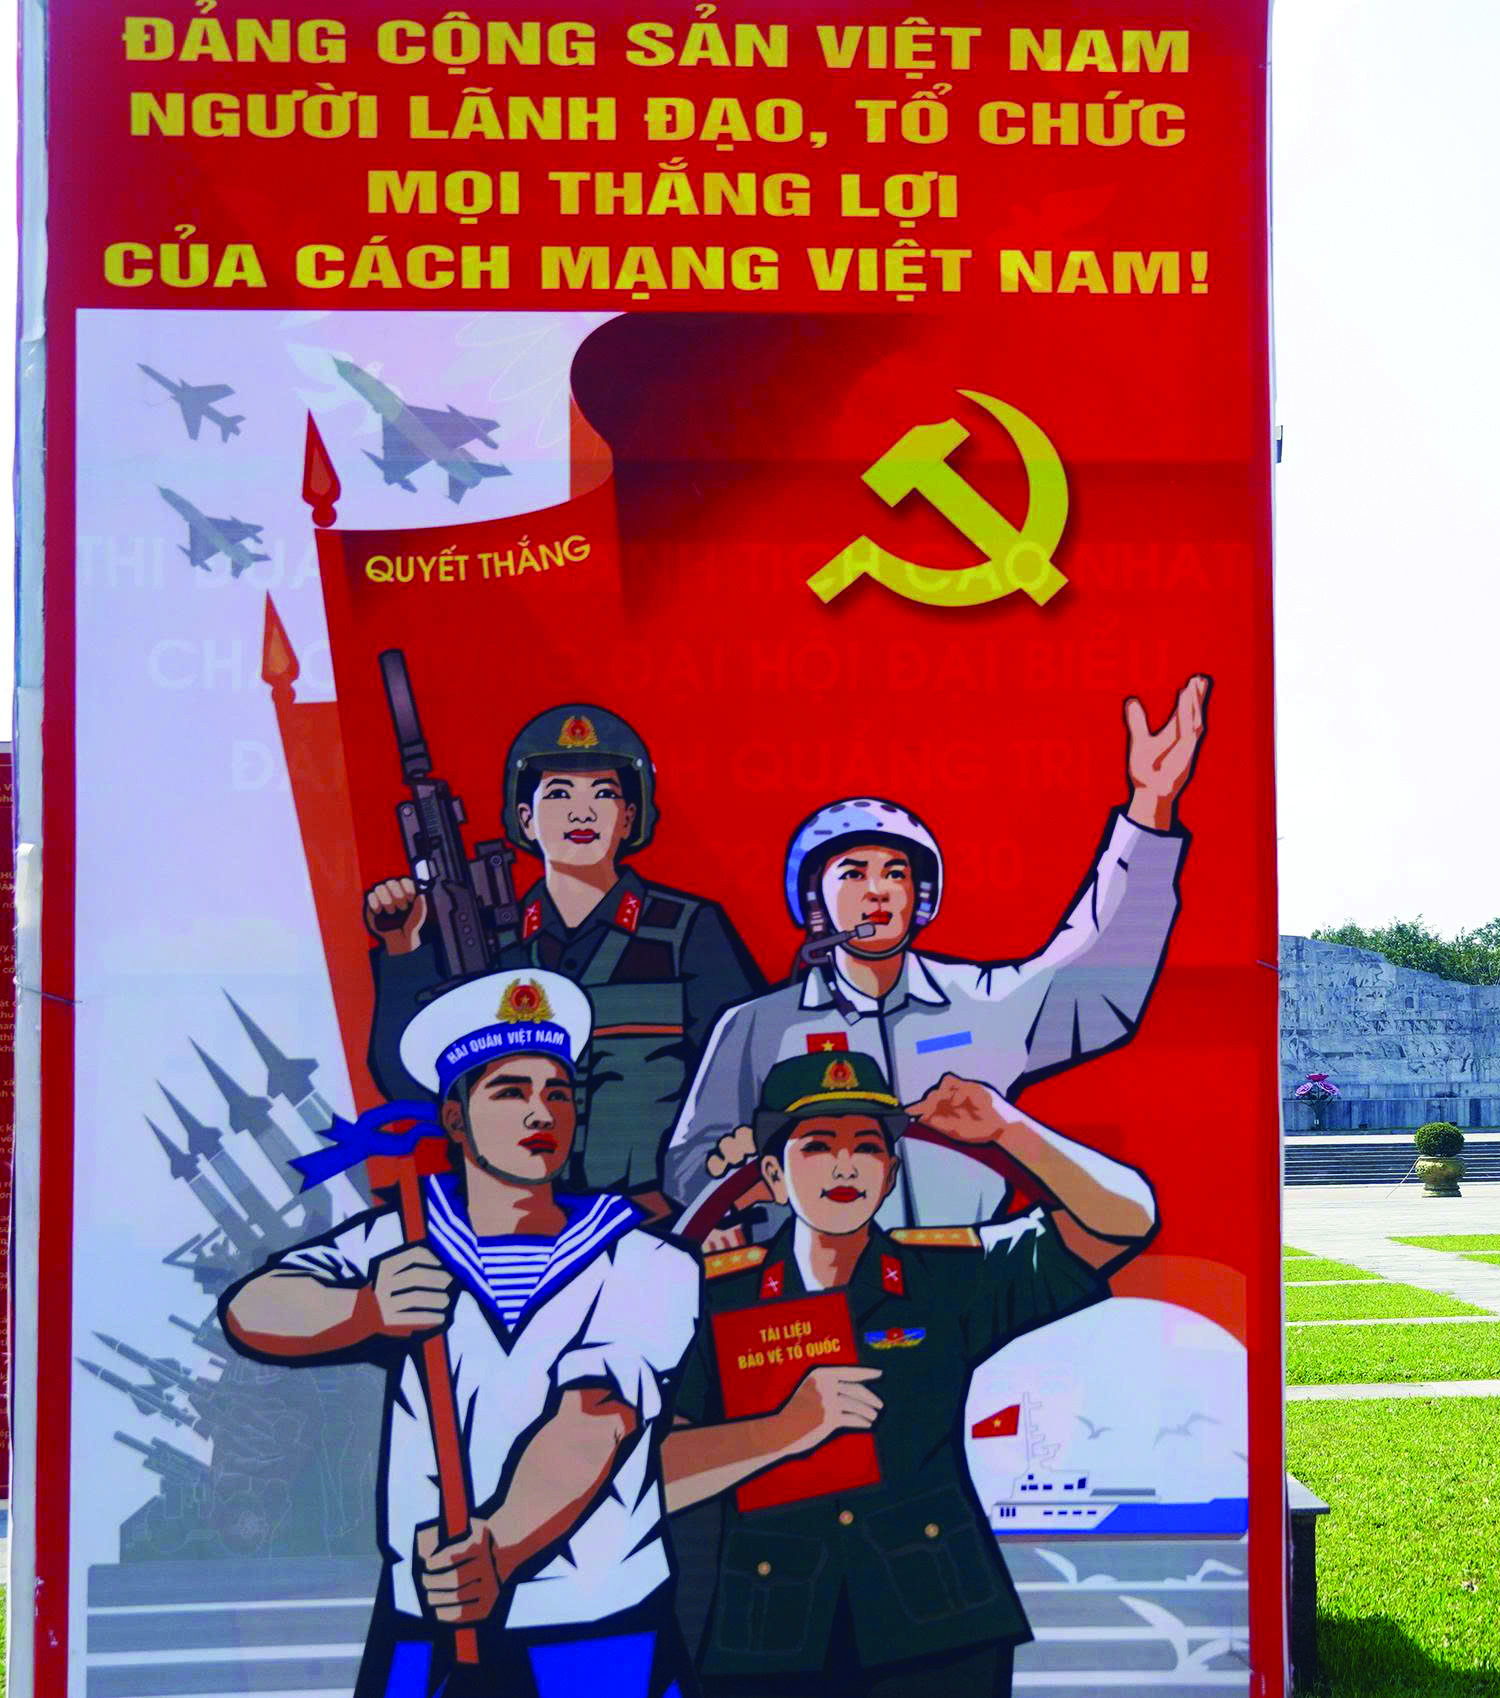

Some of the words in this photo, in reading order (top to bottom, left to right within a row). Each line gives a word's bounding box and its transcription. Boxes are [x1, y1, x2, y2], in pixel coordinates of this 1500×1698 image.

[122, 0, 346, 63] ĐẢNG
[377, 11, 595, 75] CỘNG
[626, 3, 788, 68] SẢN
[816, 17, 982, 79] VIỆT
[1010, 28, 1189, 73] NAM
[131, 82, 377, 139] NGƯỜI
[410, 87, 617, 141] LÃNH
[644, 97, 827, 151] ĐẠO,
[855, 82, 953, 144] TỔ
[979, 90, 1185, 147] CHỨC
[367, 170, 520, 225] MỌI
[548, 157, 811, 217] THẮNG
[841, 171, 958, 228] LỢI
[104, 223, 267, 288] CỦA
[296, 235, 510, 289] CÁCH
[541, 246, 779, 300] MẠNG
[807, 238, 972, 302] VIỆT
[999, 249, 1209, 294] NAM!
[365, 545, 469, 583] QUYẾT
[477, 534, 591, 579] THẮNG
[507, 1028, 532, 1046] VIỆT
[535, 1030, 565, 1046] NAM
[738, 1349, 764, 1370] BẢO
[806, 1335, 841, 1358] QUỐC
